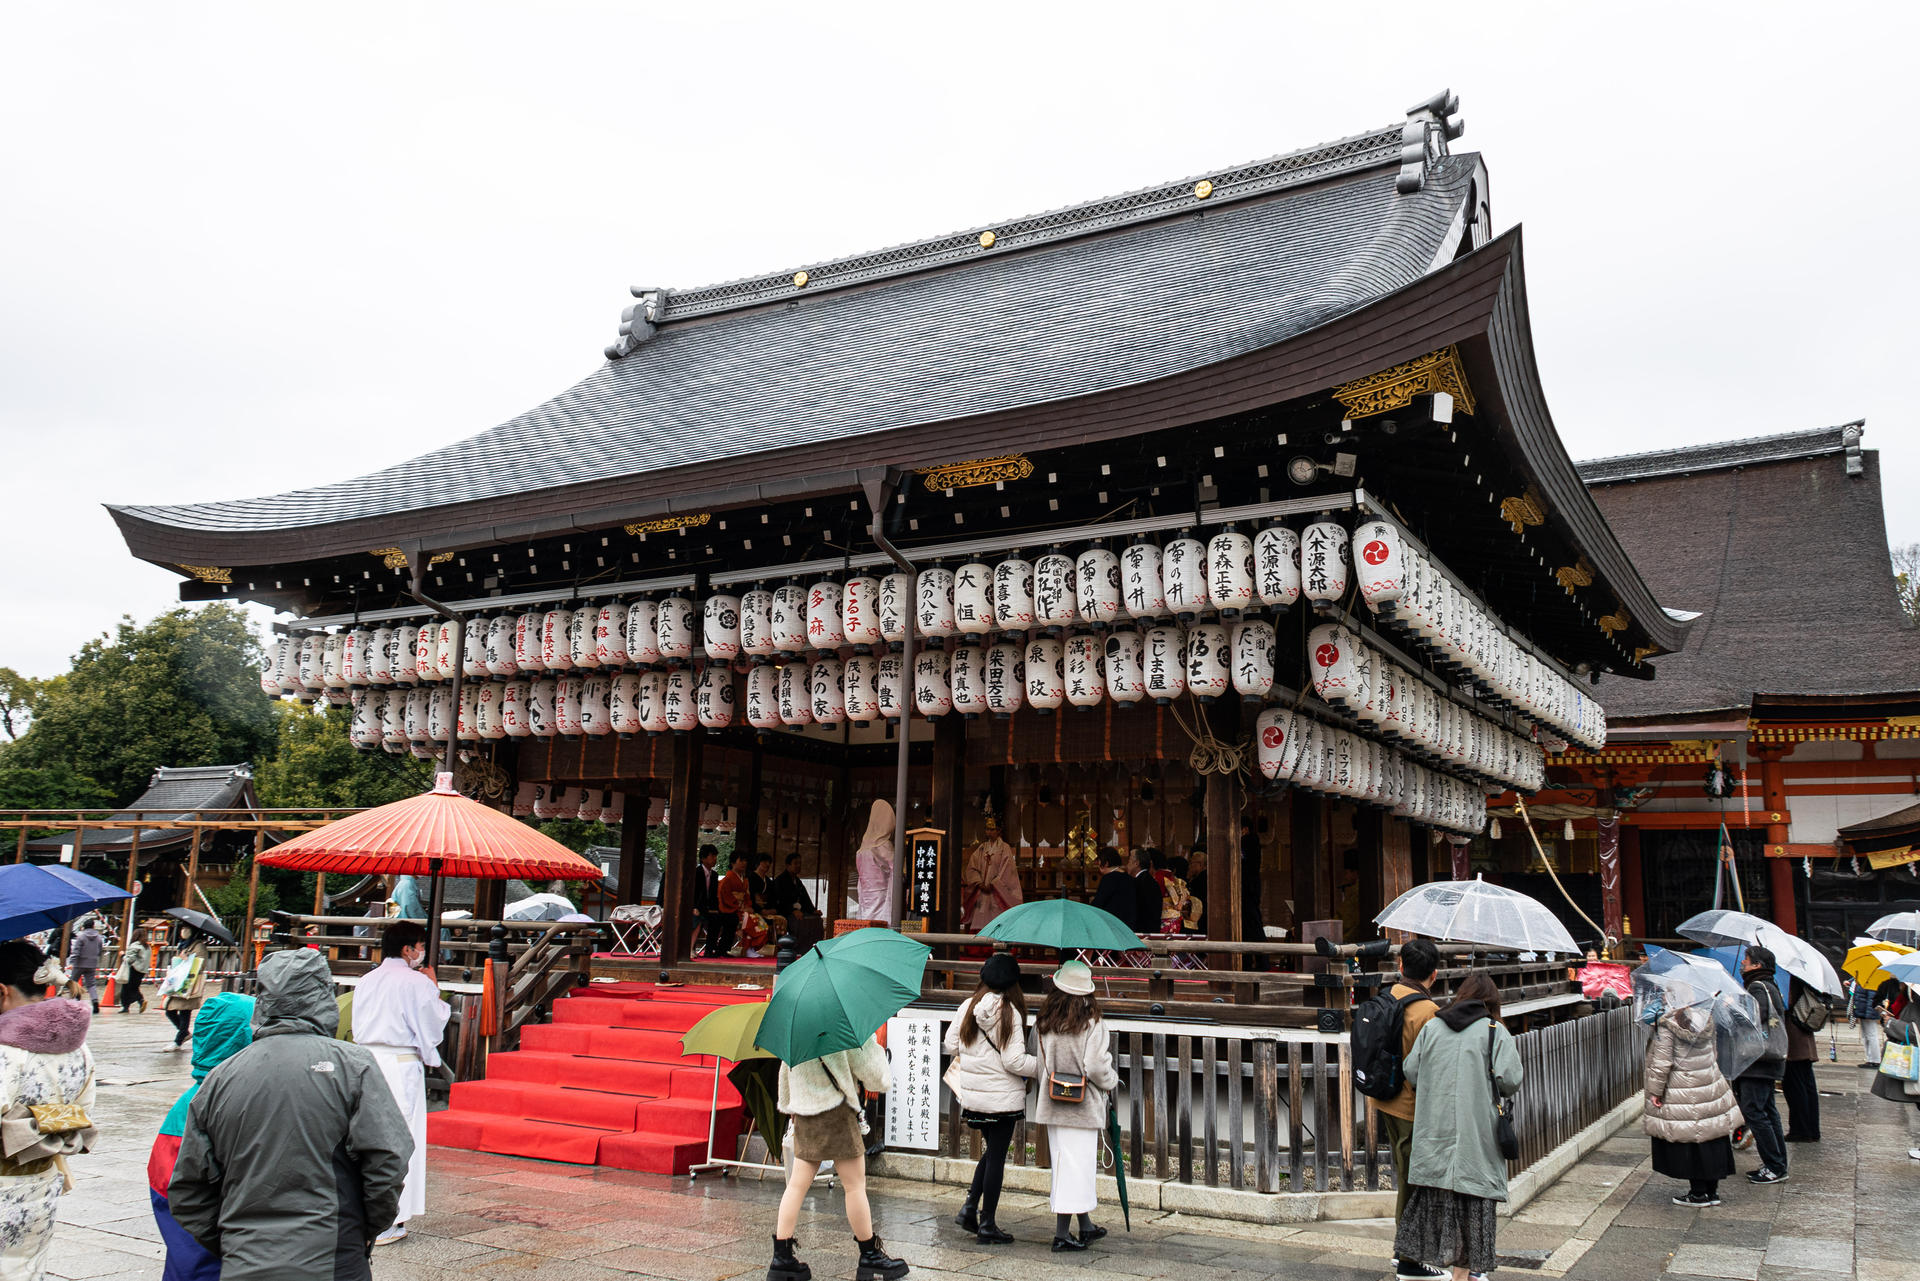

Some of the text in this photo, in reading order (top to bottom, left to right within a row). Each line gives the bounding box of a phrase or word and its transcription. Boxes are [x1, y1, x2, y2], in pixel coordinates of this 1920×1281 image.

[1126, 547, 1145, 610] 菊乃井
[1166, 542, 1186, 606] 菊乃井
[1214, 537, 1234, 601] 祐森正幸
[1260, 531, 1282, 597] 八木源太郎
[1306, 527, 1330, 594] 八木源太郎
[773, 589, 788, 641] 岡あい
[809, 589, 824, 635] 多麻
[846, 582, 861, 632] てる子
[881, 578, 898, 633] 美の八重
[921, 572, 938, 626] 美の八重
[957, 570, 976, 621] 大恒
[996, 564, 1014, 621] 登喜家
[1079, 558, 1099, 619] 菊乃井
[660, 600, 674, 650] 井上八千代
[955, 650, 970, 704] 田崎真也
[1069, 639, 1086, 696] 満彩美
[1149, 630, 1167, 690] こじま屋
[582, 683, 595, 723] 川口
[666, 674, 682, 723] 元奈古
[814, 664, 830, 717] みの家
[907, 1023, 917, 1143] 結婚式をお受けします
